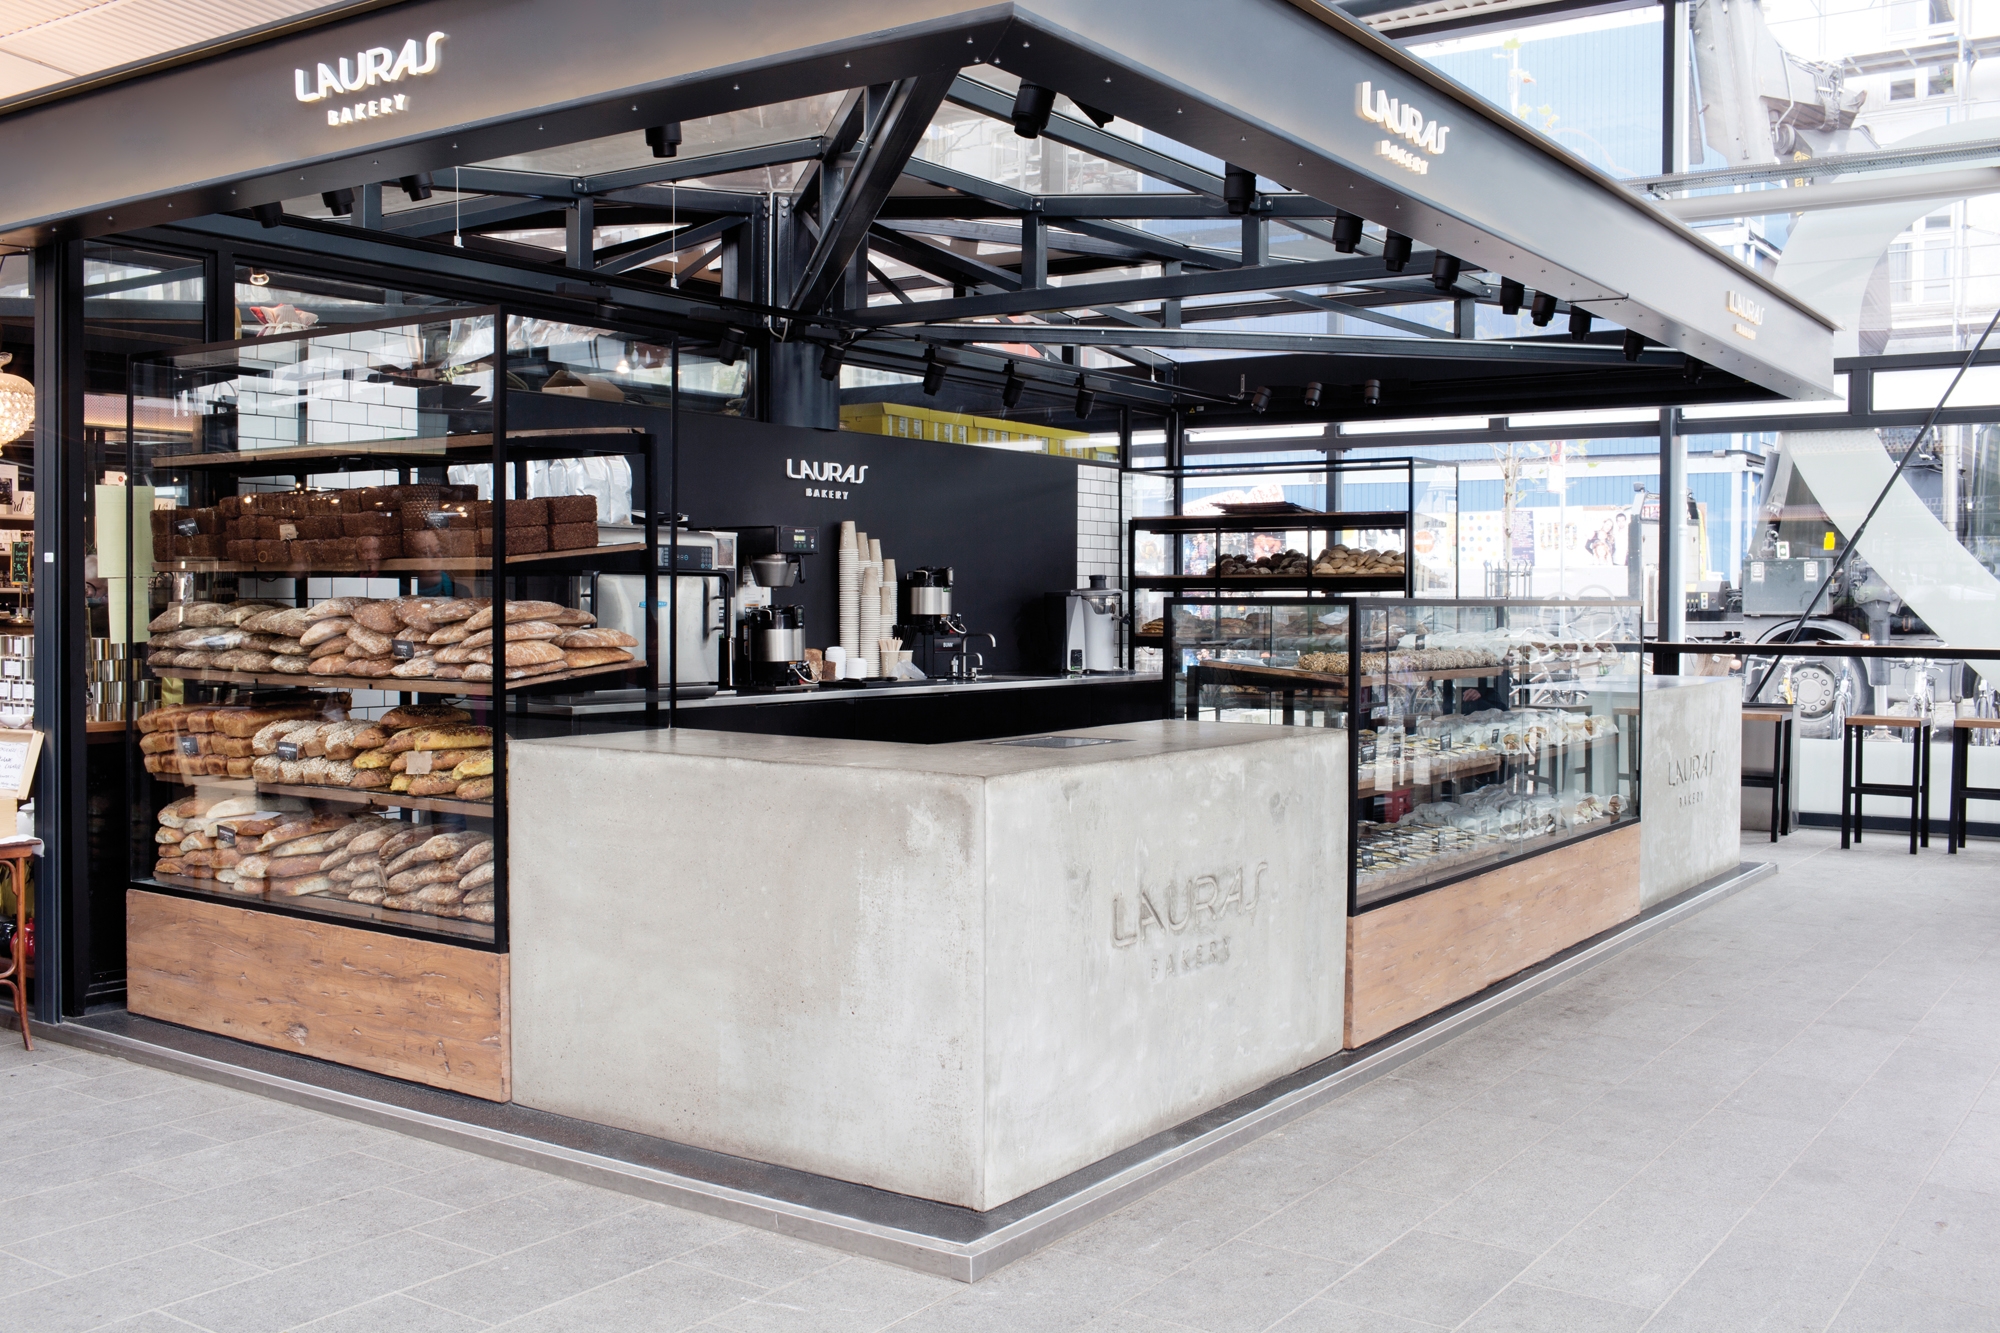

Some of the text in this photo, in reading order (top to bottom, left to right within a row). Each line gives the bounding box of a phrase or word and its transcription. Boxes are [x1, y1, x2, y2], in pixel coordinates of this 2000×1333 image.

[295, 31, 445, 102] LAURAS
[327, 93, 406, 126] BAKERY
[1361, 81, 1450, 154] LAURAS
[1381, 140, 1429, 174] BAKERY
[1729, 290, 1765, 325] LAURAS
[786, 458, 869, 484] LAURAS
[805, 487, 849, 500] BAKERY
[1668, 749, 1716, 788] LAURAS
[1679, 791, 1704, 808] BAKERY
[1111, 861, 1268, 948] LAURAS
[1150, 936, 1231, 980] BAKERY
